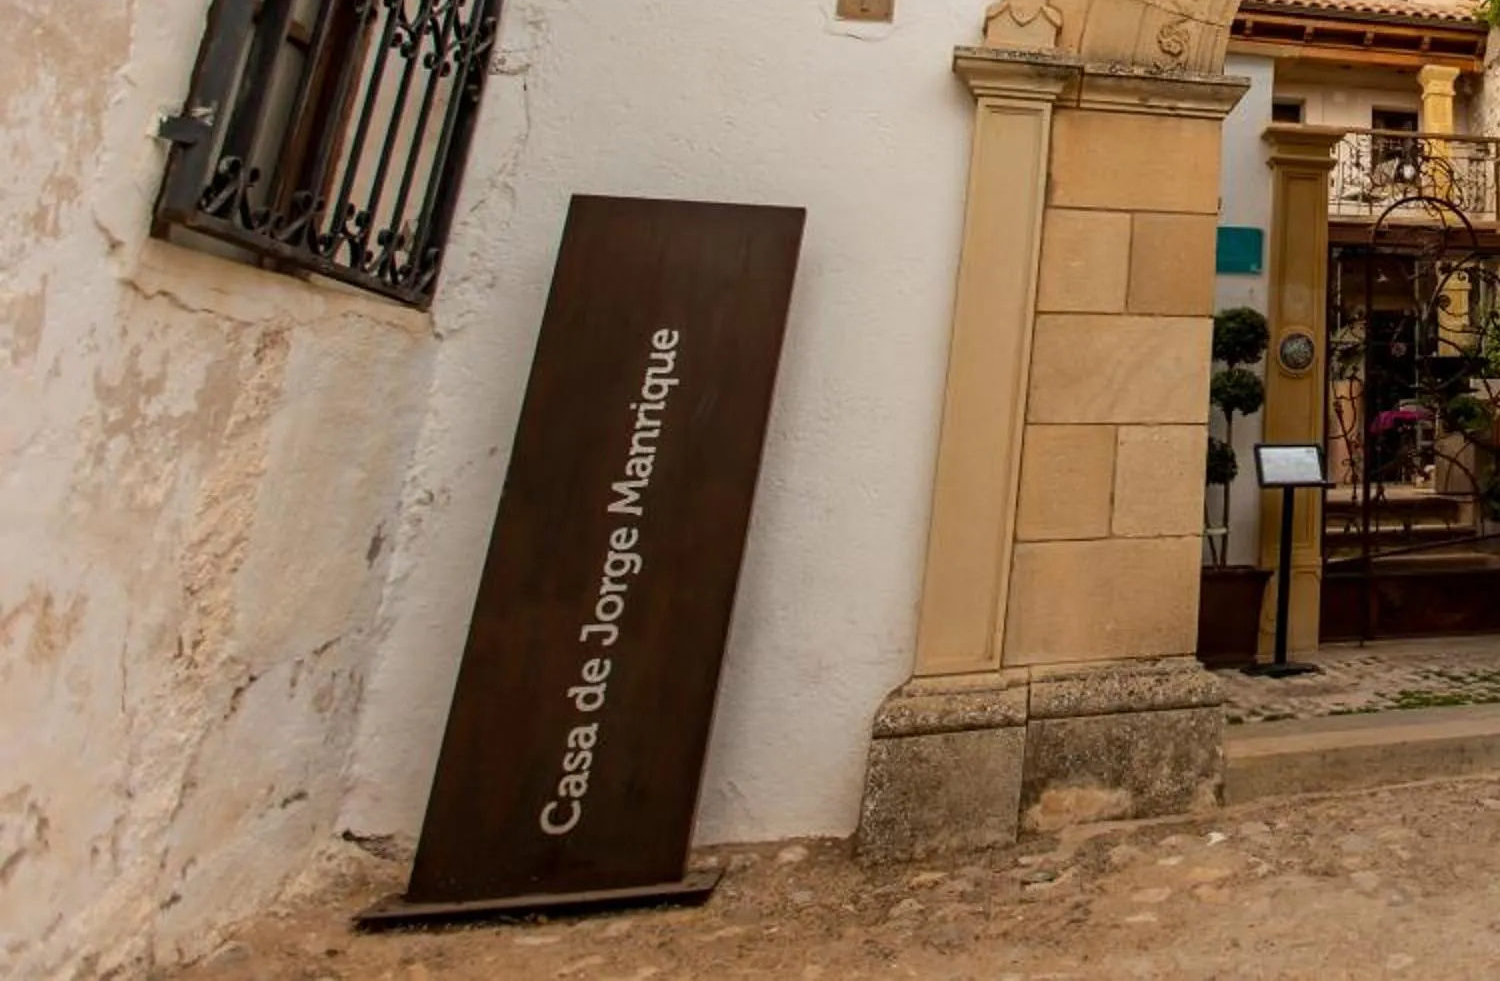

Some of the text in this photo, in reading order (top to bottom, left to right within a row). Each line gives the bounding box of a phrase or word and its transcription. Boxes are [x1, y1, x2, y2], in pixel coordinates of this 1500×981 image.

[540, 327, 680, 835] Casa de Jorge Manrique
